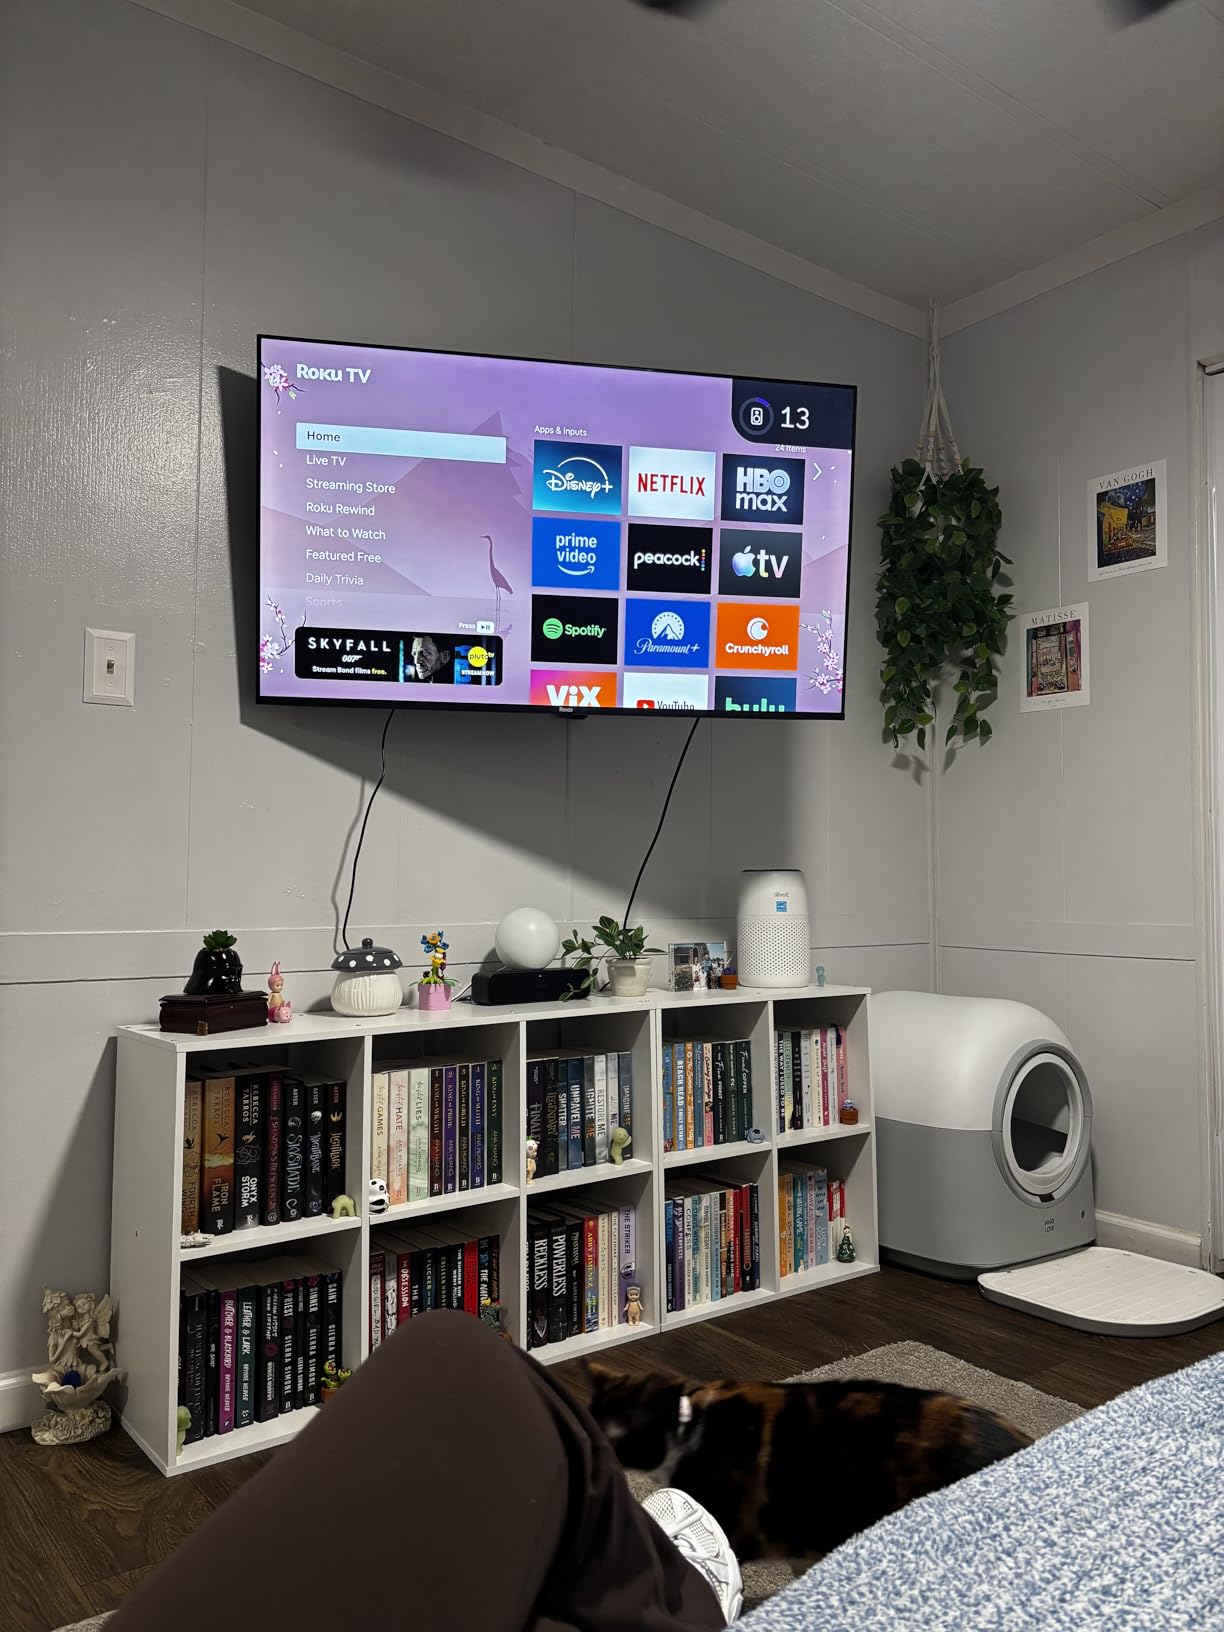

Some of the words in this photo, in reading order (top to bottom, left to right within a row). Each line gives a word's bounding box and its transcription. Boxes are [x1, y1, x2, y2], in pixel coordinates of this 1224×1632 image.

[296, 363, 342, 381] Roku
[346, 367, 371, 383] TV
[780, 406, 810, 429] 13
[307, 430, 341, 442] Home
[534, 425, 554, 436] Apps
[555, 426, 562, 434] &
[563, 427, 587, 437] Inputs
[306, 454, 328, 466] Live
[331, 456, 347, 466] TV
[306, 478, 363, 493] Streaming
[366, 481, 396, 493] Store
[637, 472, 706, 496] NETFLIX
[736, 466, 791, 494] HBO
[1098, 478, 1120, 490] VAN
[1123, 468, 1153, 483] GOGH
[306, 502, 333, 514] Roku
[336, 504, 375, 516] Rewind
[735, 492, 787, 512] max
[306, 526, 334, 537] What
[337, 527, 349, 538] to
[351, 528, 386, 540] Watch
[555, 532, 597, 549] prime
[306, 549, 354, 562] Featured
[357, 551, 382, 563] Free
[557, 546, 596, 564] video
[633, 551, 700, 569] peacock
[757, 549, 789, 578] tv
[306, 573, 332, 585] Daily
[336, 574, 364, 585] Trivia
[305, 597, 343, 609] Sports
[1031, 609, 1077, 625] MATISSE
[564, 623, 604, 638] Spotify
[307, 636, 391, 653] SKYFALL
[633, 637, 700, 655] Paramount+
[725, 642, 789, 656] Crunchyroll
[312, 665, 337, 674] Stream
[337, 666, 354, 675] Bond
[355, 666, 371, 675] films
[372, 667, 388, 676] free.
[546, 684, 601, 707] ViX
[223, 1087, 231, 1127] REBECCA
[546, 1092, 558, 1136] LEGENDARY
[558, 1093, 567, 1126] SHATTER
[570, 1085, 580, 1124] UNRAVEL
[586, 1088, 594, 1119] IGNITE
[597, 1090, 605, 1122] RESTORE
[597, 1124, 605, 1136] ME
[610, 1113, 617, 1125] ME
[571, 1126, 580, 1140] ME
[586, 1124, 595, 1138] ME
[309, 1132, 322, 1173] NIGHTBANE
[329, 1132, 342, 1169] LIGHTLARK
[286, 1134, 303, 1193] SKYSHADE
[188, 1182, 197, 1216] FOURTH
[211, 1178, 221, 1213] FLAME
[221, 1183, 229, 1205] IRON
[241, 1176, 250, 1207] STORM
[249, 1178, 258, 1203] ONYX
[480, 1269, 488, 1282] THE
[534, 1239, 548, 1290] RECKLESS
[552, 1234, 567, 1297] POWERLESS
[328, 1283, 337, 1304] SAINT
[401, 1268, 409, 1307] OBSESSION
[283, 1292, 294, 1317] PRIEST
[309, 1287, 318, 1312] SINNER
[224, 1300, 234, 1326] BUTCHER
[242, 1302, 252, 1327] LEATHER
[242, 1336, 251, 1355] LARK
[284, 1335, 292, 1361] SIERRA
[309, 1328, 317, 1355] SIERRA
[328, 1324, 336, 1351] SIERRA
[224, 1335, 233, 1368] BLACKBIRD
[284, 1366, 292, 1395] SIMONE
[308, 1358, 316, 1387] SIMONE
